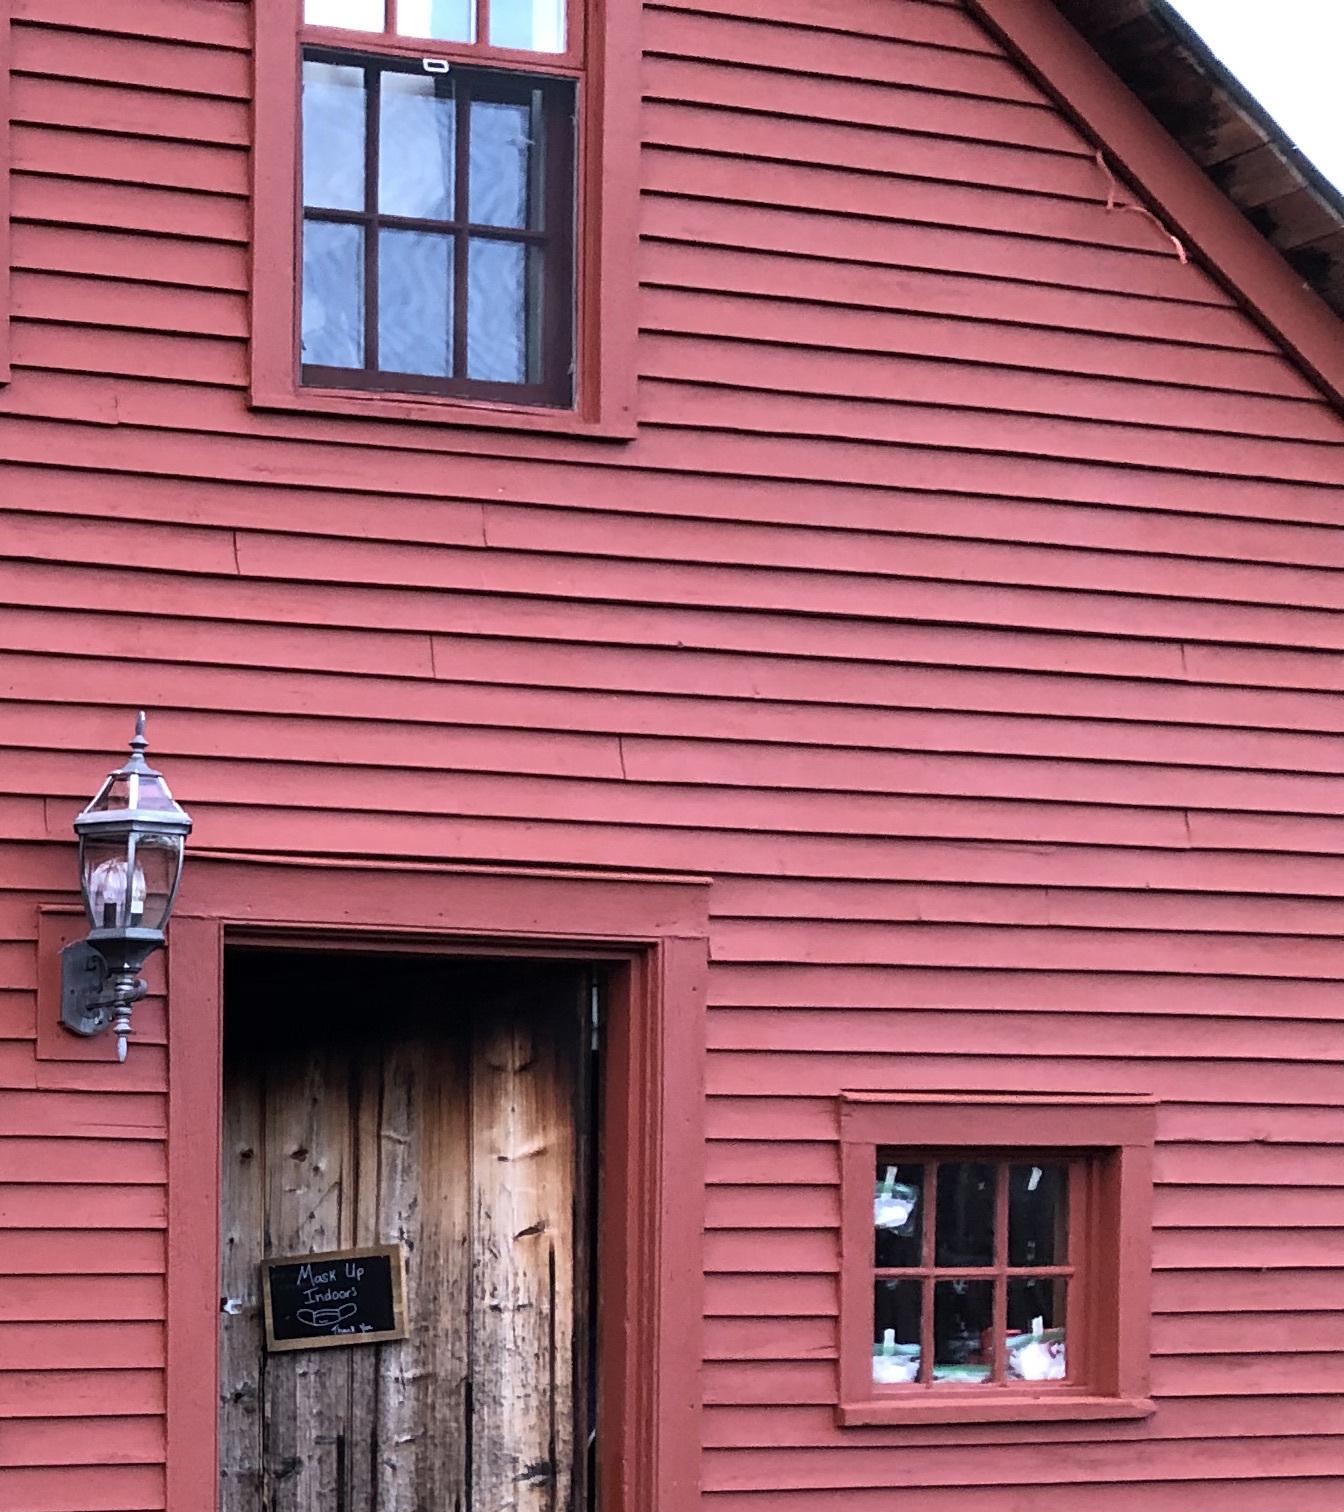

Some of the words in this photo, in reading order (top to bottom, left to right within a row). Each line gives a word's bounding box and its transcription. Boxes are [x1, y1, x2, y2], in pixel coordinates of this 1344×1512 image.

[297, 1264, 337, 1286] Mask
[345, 1263, 365, 1281] Up
[303, 1287, 357, 1304] Indoors
